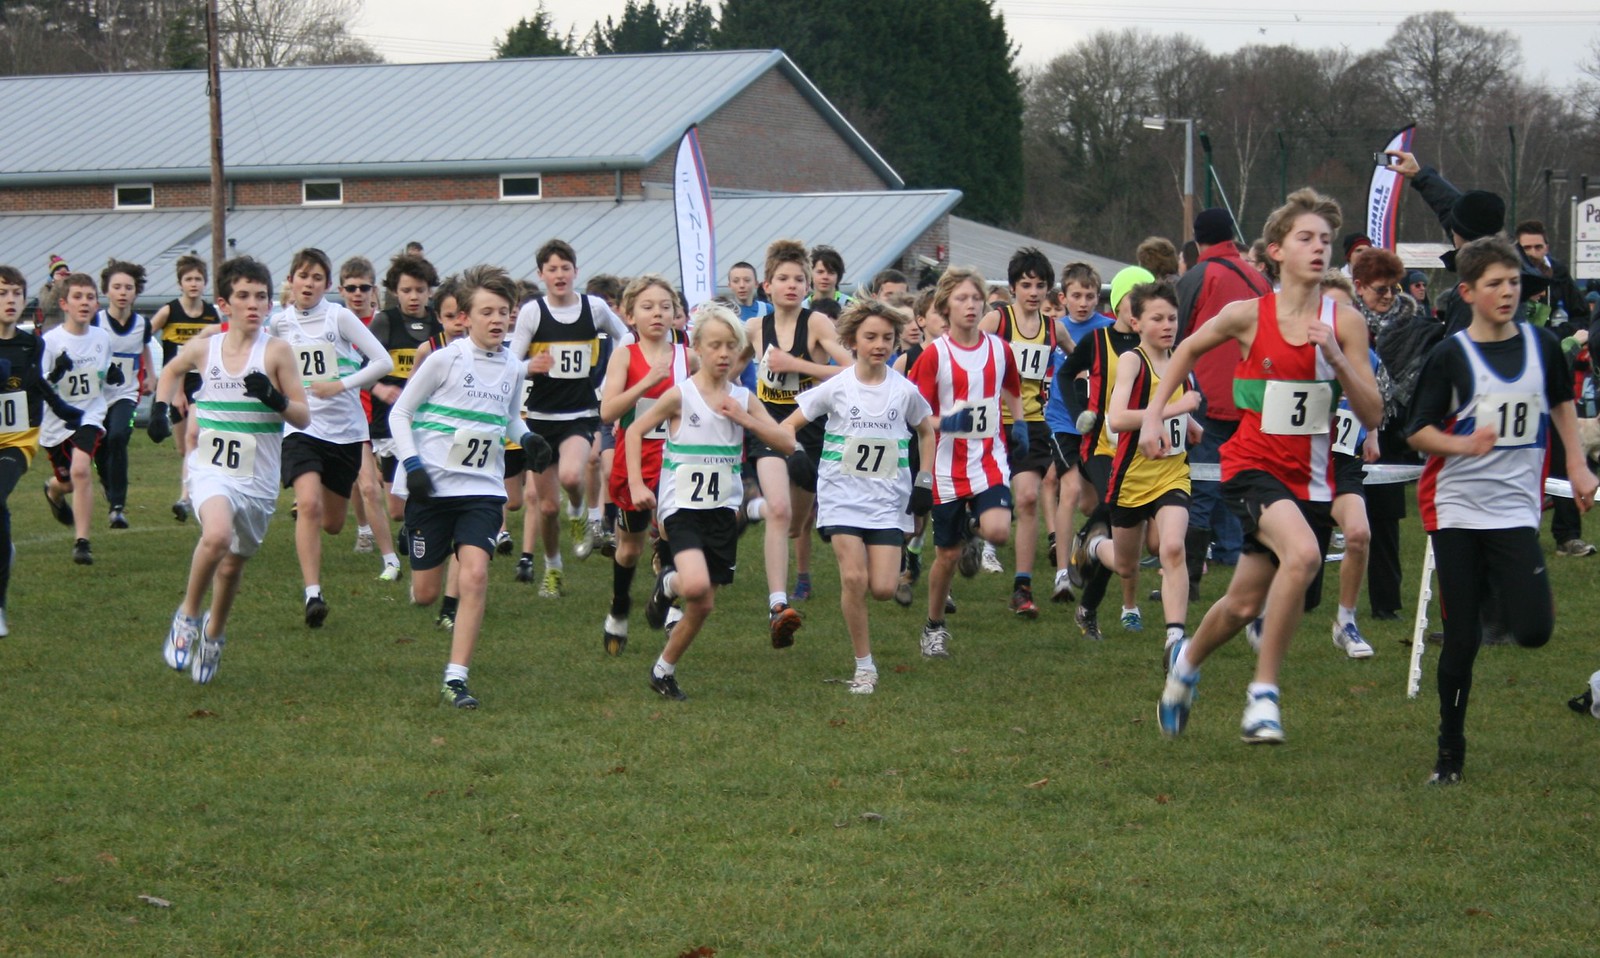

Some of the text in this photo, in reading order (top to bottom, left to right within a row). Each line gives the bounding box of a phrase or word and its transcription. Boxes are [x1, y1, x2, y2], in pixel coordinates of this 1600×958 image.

[300, 350, 325, 376] 28
[561, 350, 582, 373] 59
[1021, 349, 1041, 373] 14
[69, 374, 90, 396] 25
[0, 399, 15, 426] 0
[1291, 392, 1308, 426] 3
[1498, 402, 1528, 438] 18
[852, 421, 893, 430] GUERNSEY
[212, 437, 241, 469] 26
[461, 438, 492, 468] 23
[856, 444, 886, 472] 27
[690, 472, 719, 502] 24
